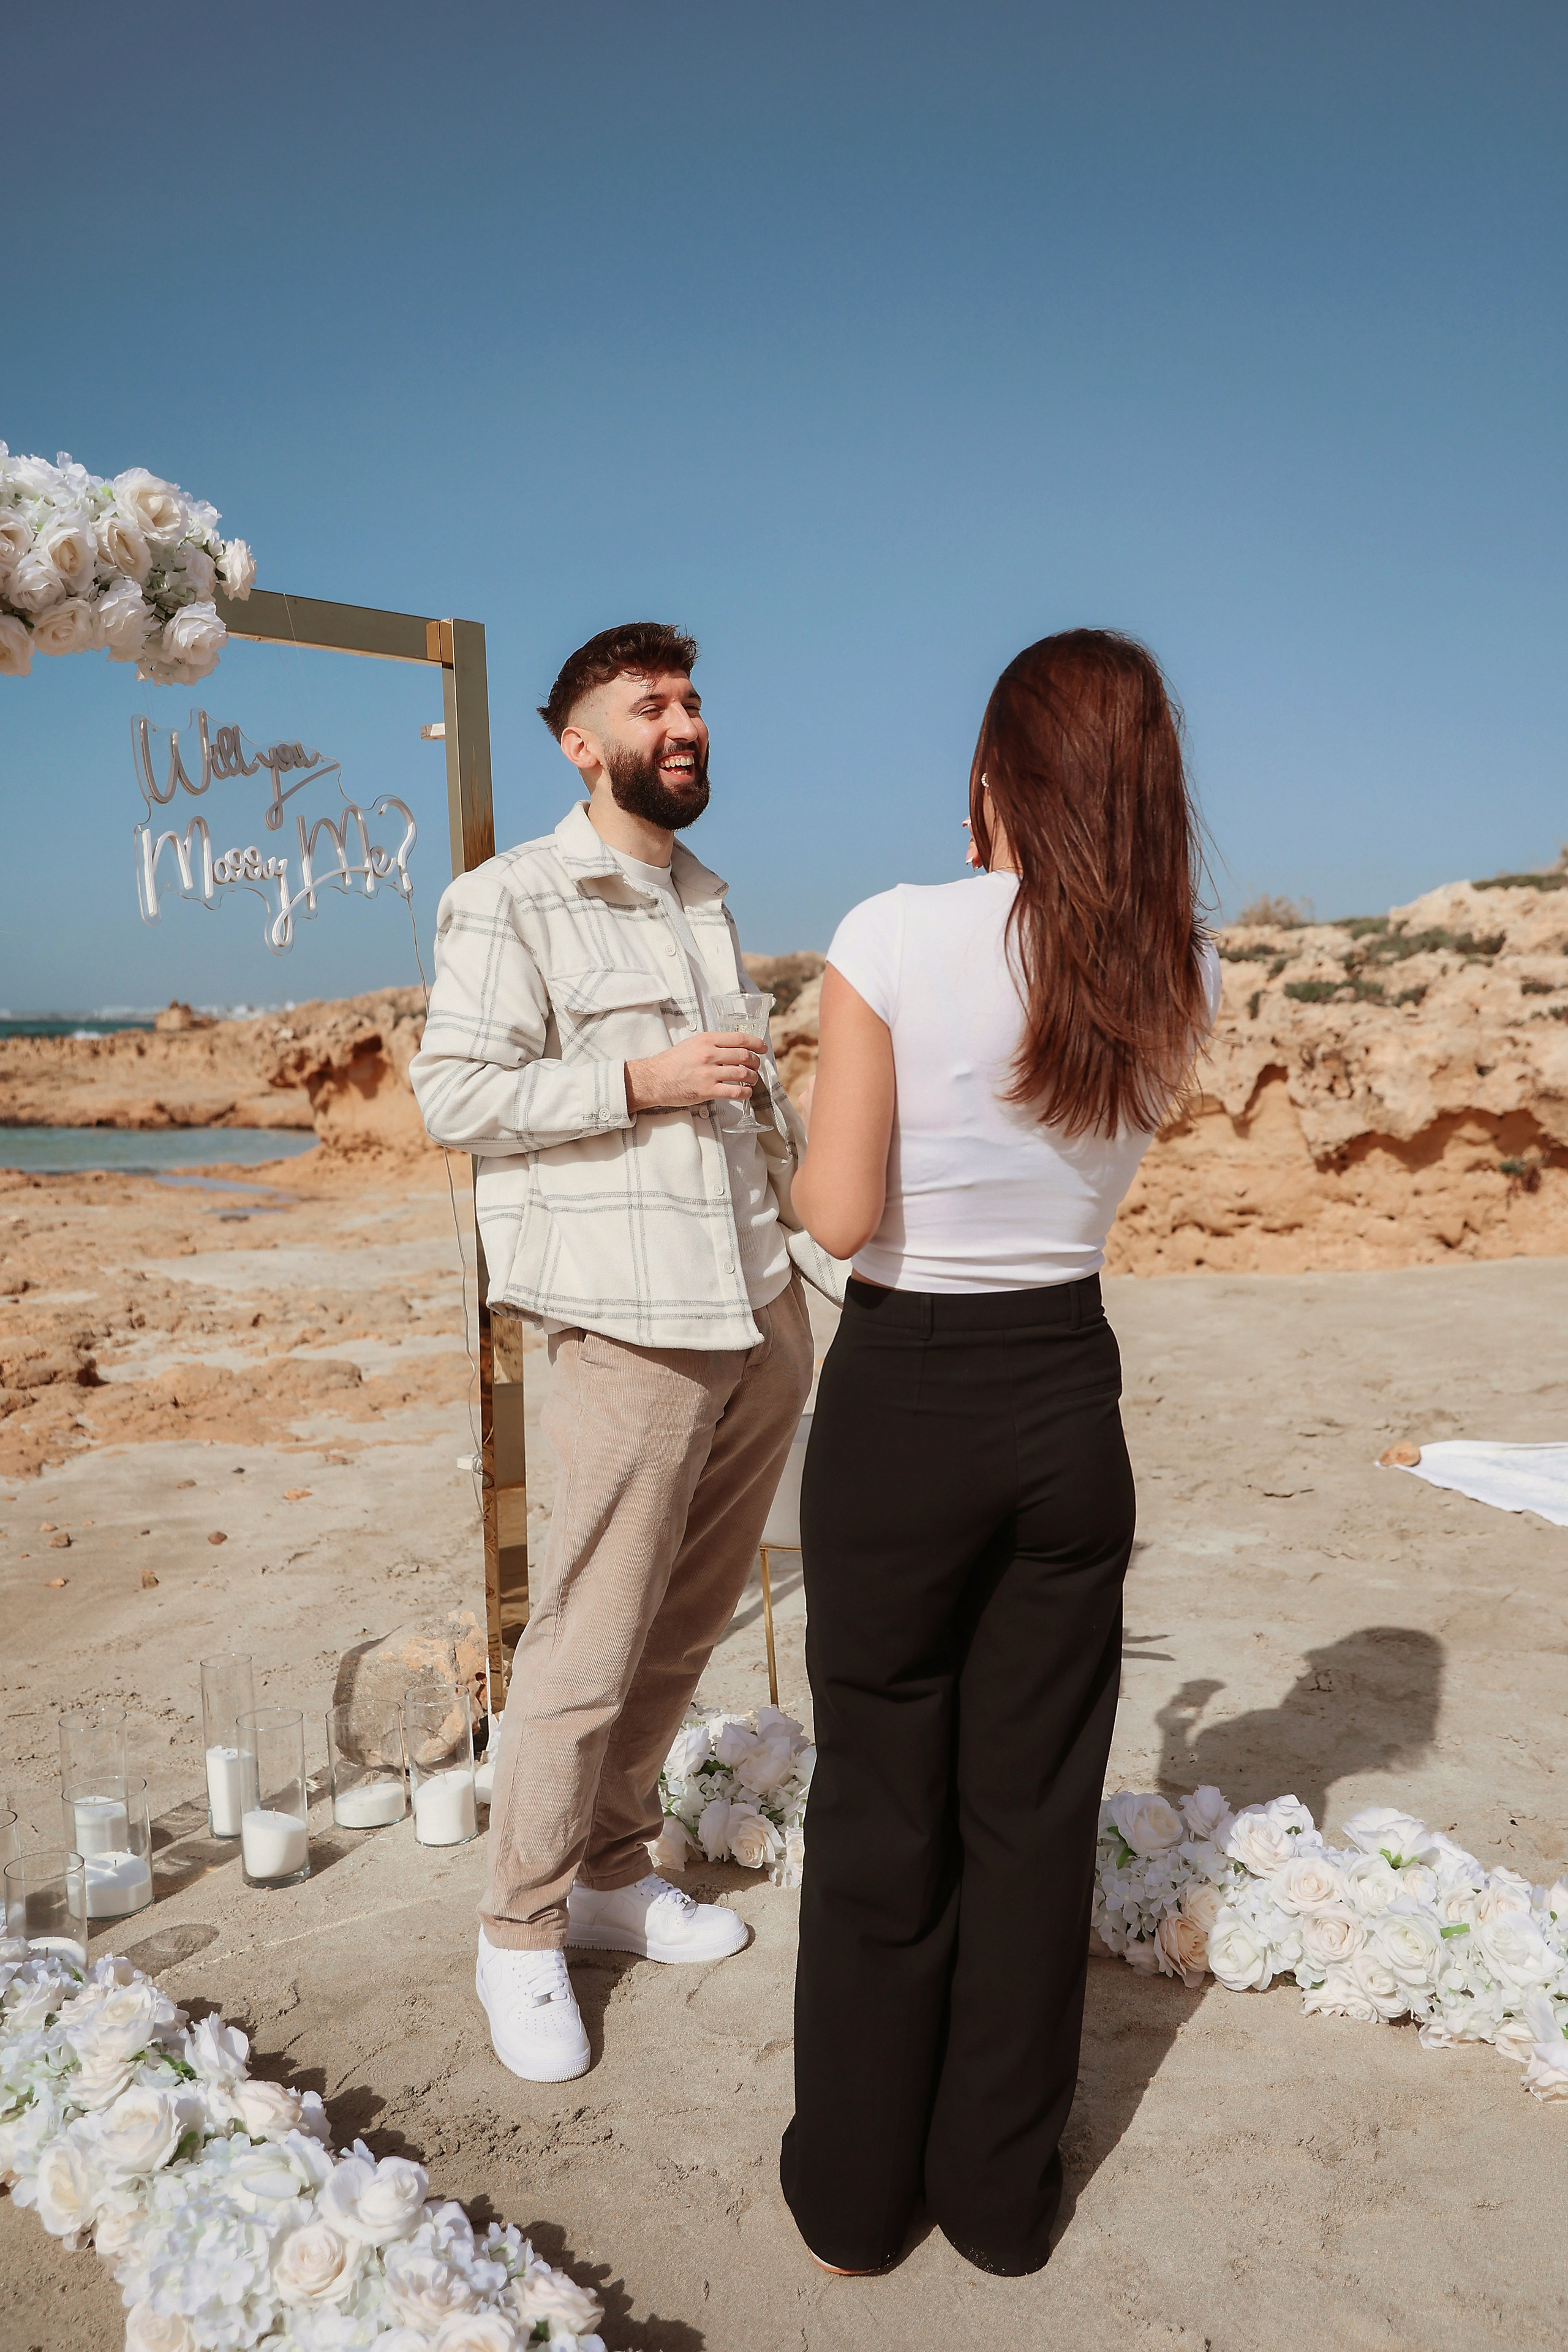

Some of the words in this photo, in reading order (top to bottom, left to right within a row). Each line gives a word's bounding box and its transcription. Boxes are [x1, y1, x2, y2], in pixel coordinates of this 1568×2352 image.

[140, 710, 259, 804] Will
[255, 742, 341, 831] you
[141, 816, 371, 947] Marry
[296, 799, 418, 911] Me?
